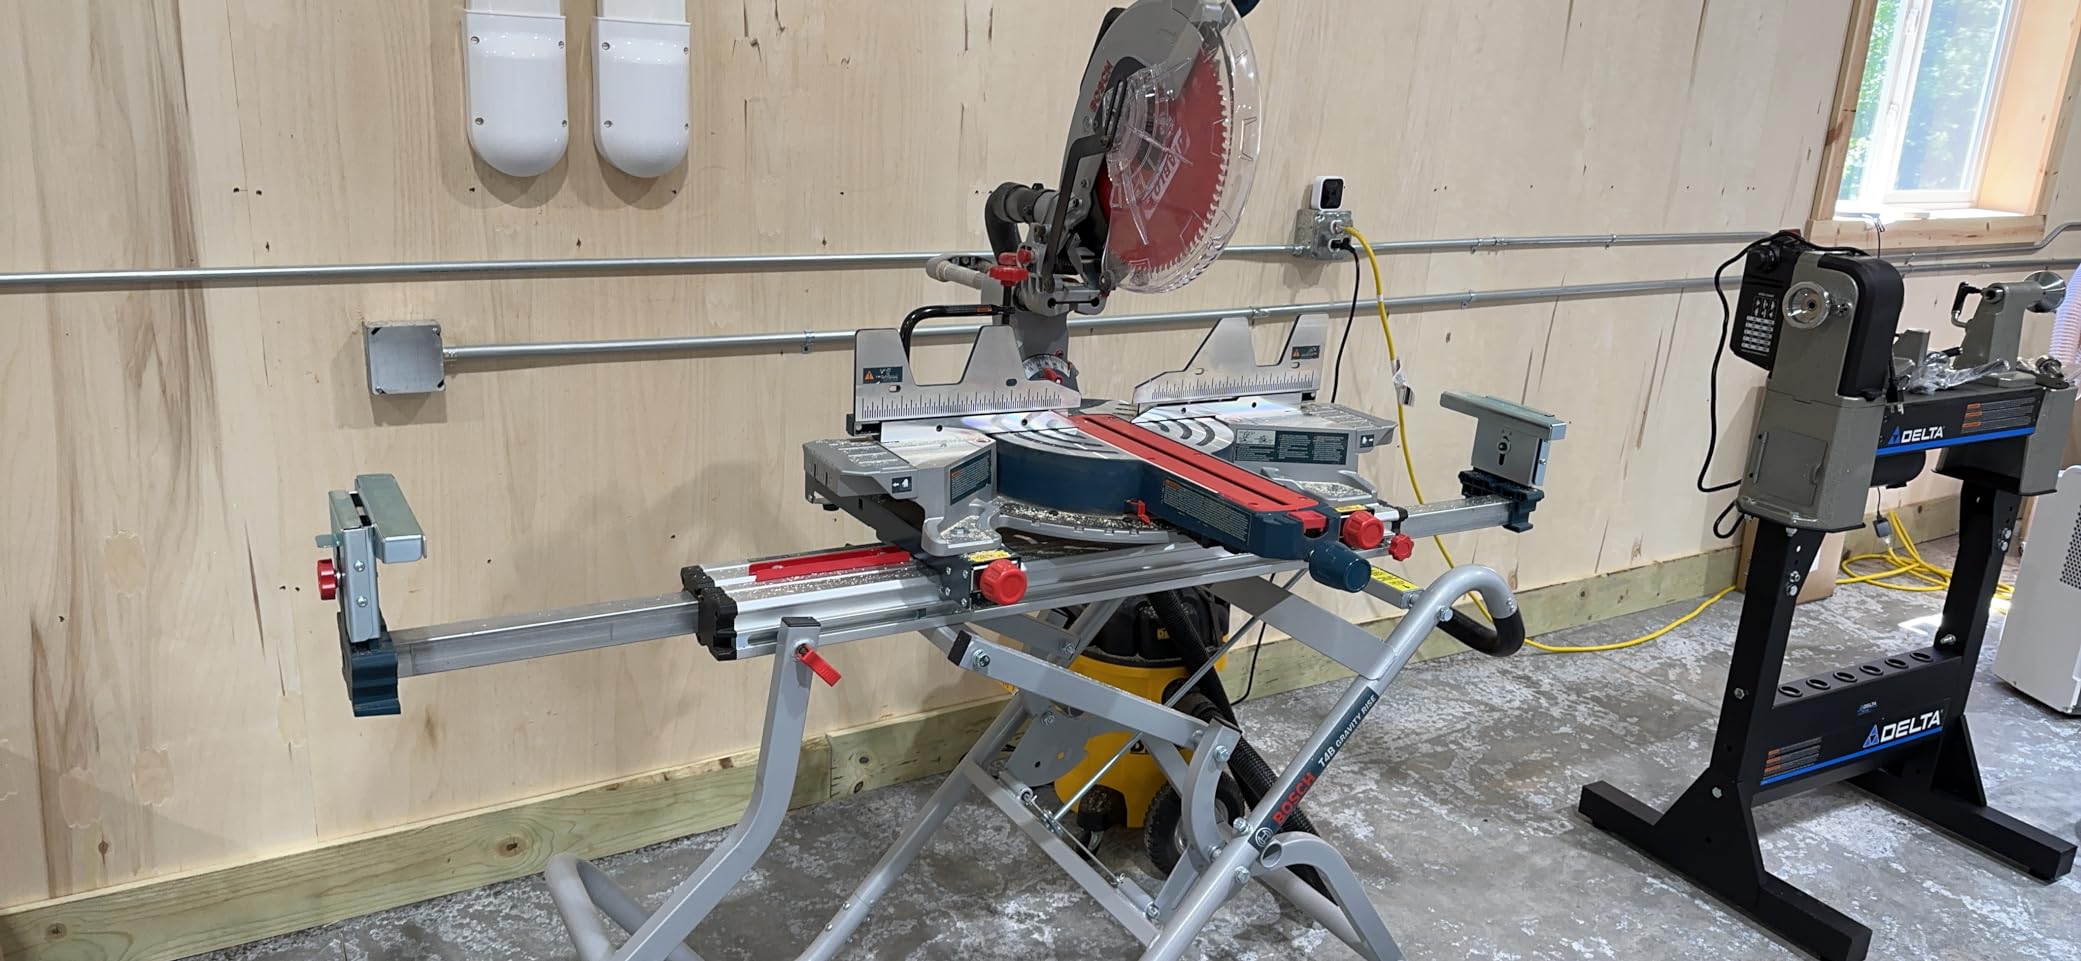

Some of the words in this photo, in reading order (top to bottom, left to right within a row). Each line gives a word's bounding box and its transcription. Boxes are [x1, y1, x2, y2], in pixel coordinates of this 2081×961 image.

[1901, 426, 1944, 443] DELTA
[1881, 711, 1941, 743] DELTA
[1272, 772, 1317, 824] BOSCH
[1318, 745, 1336, 767] T4B
[1335, 713, 1362, 748] GRAVITY
[1361, 695, 1377, 714] RISE
